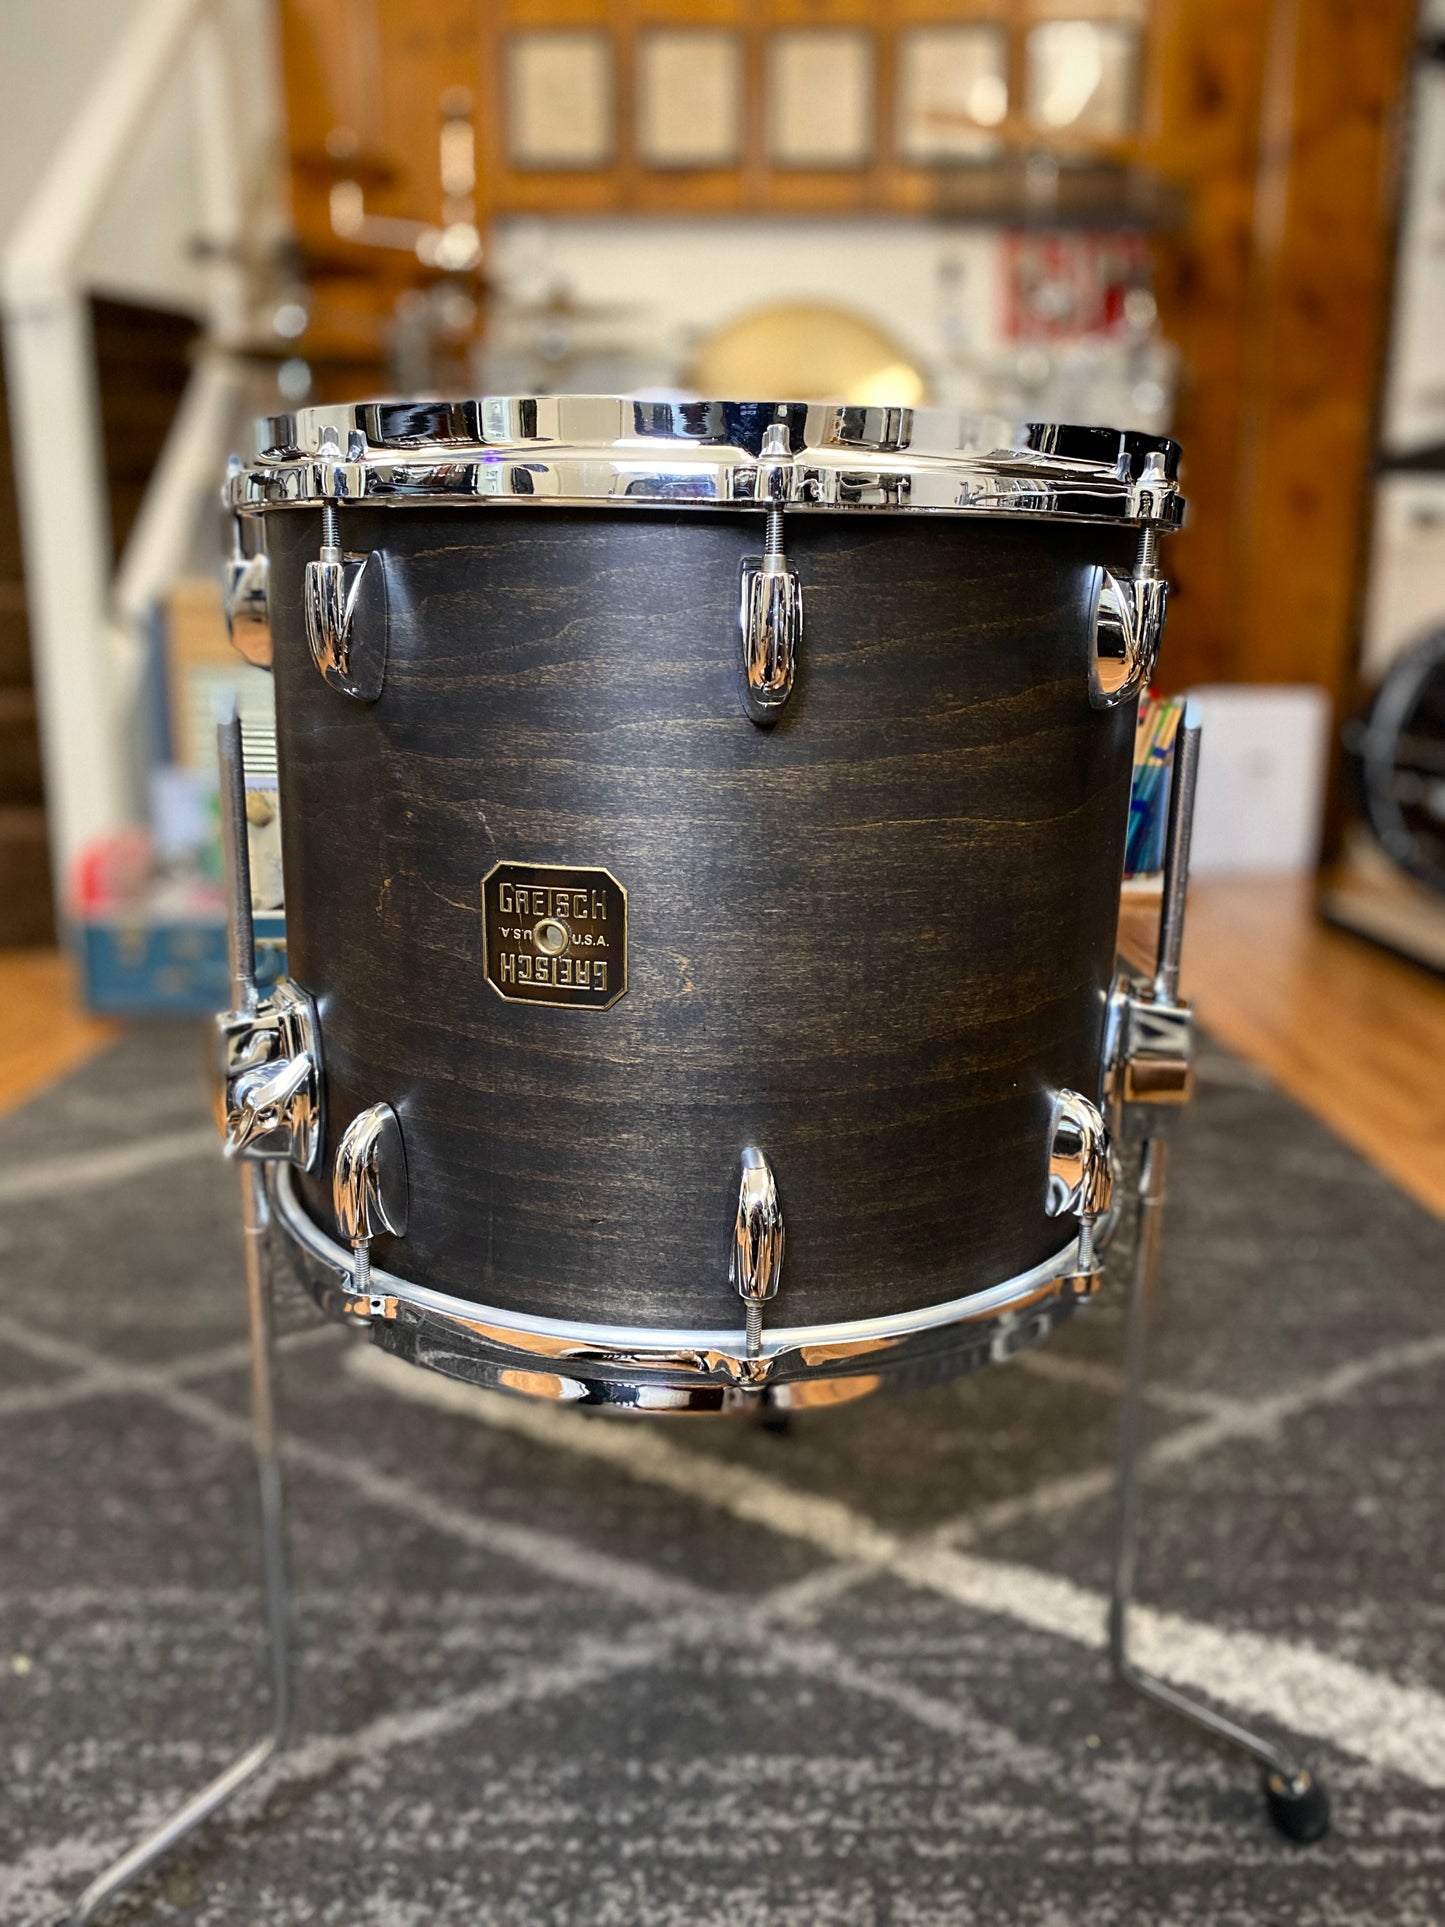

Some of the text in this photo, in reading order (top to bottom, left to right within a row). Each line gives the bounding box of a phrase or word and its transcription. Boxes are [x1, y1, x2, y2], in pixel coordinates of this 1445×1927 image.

[499, 882, 608, 920] GRETSCH
[498, 926, 533, 940] U.S.A.
[571, 933, 610, 947] U.S.A.
[500, 952, 608, 992] GRETSCH
